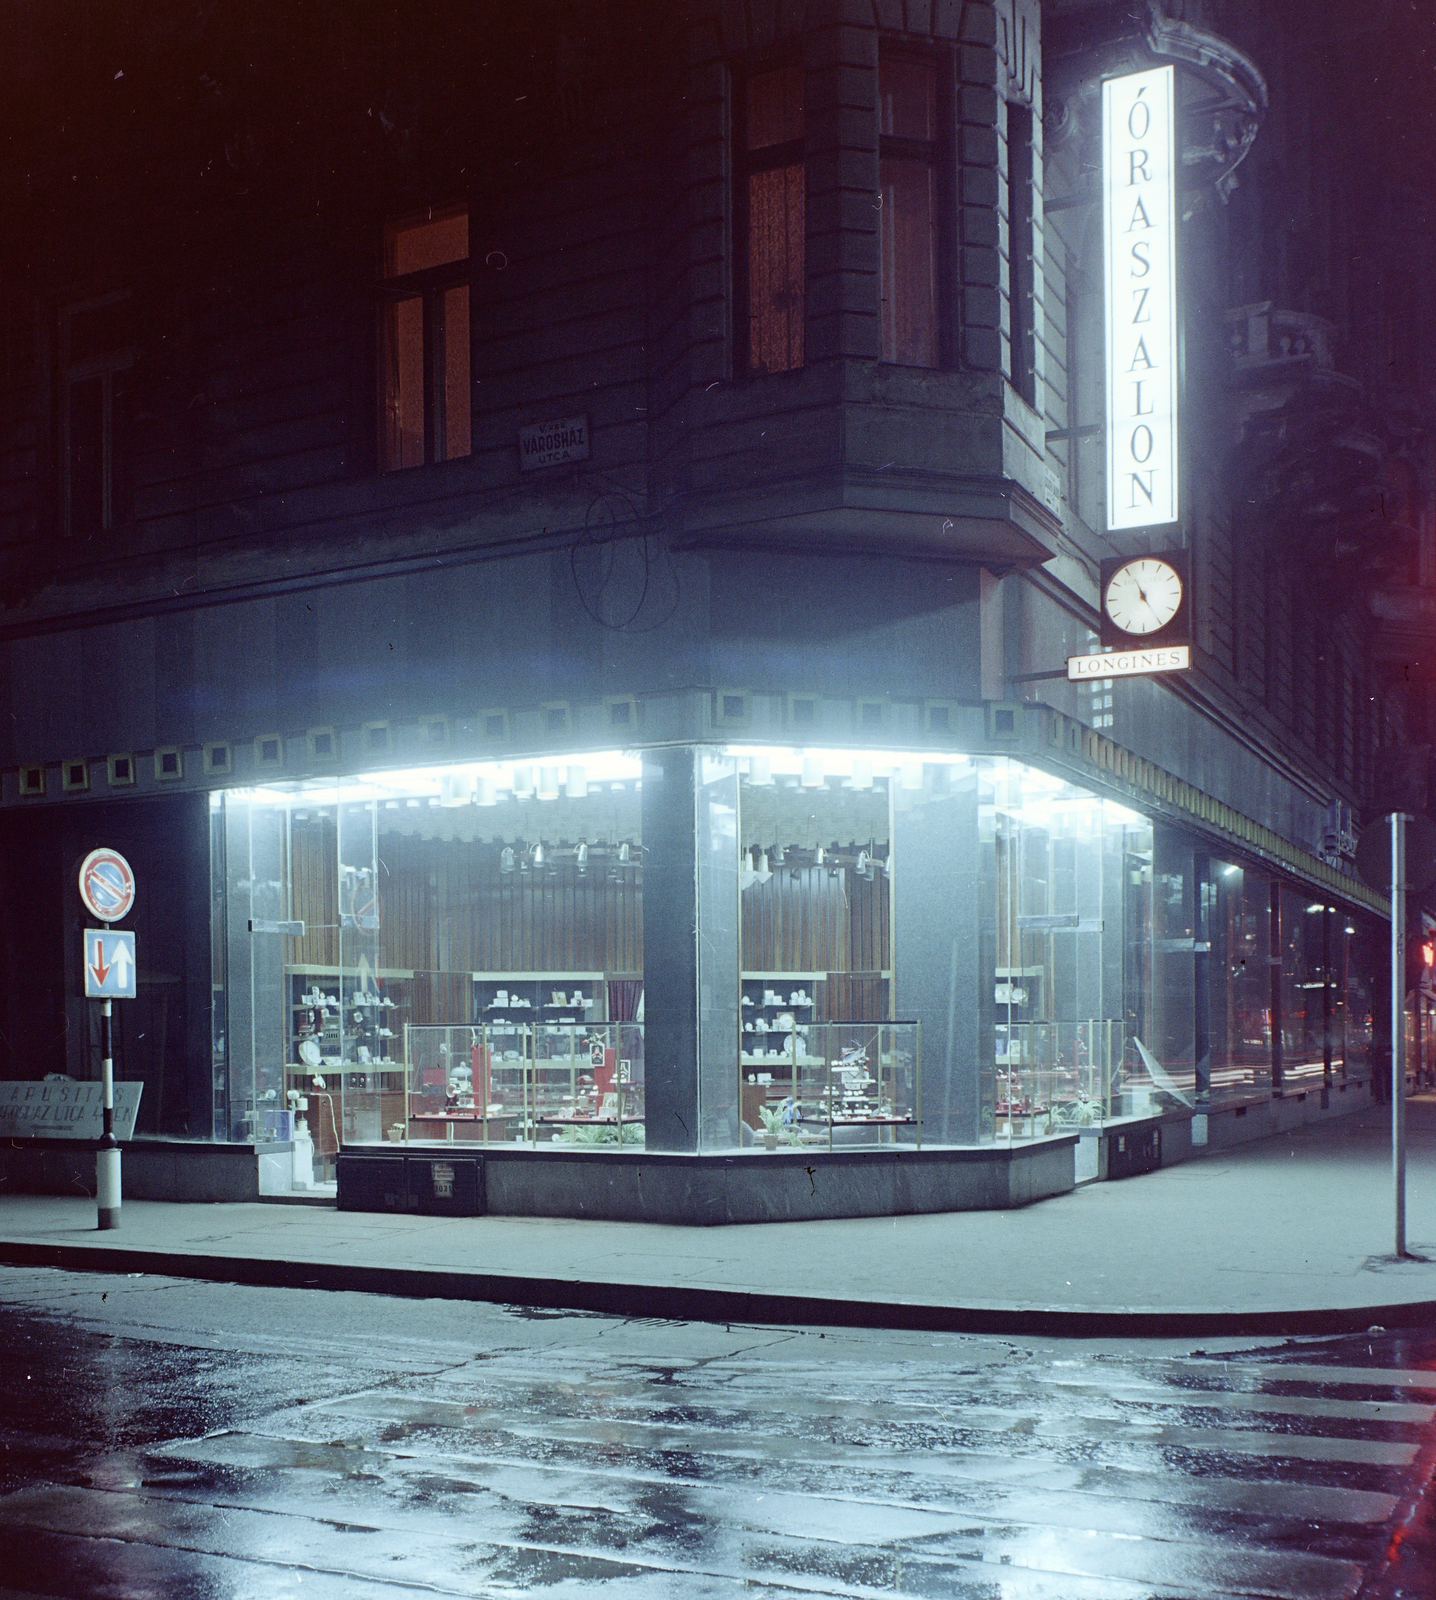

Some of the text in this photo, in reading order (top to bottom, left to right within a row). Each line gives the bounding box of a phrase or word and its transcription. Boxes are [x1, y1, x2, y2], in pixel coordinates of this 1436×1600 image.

[1124, 86, 1159, 509] ÓRASZALON
[538, 450, 571, 464] UTCA
[1076, 651, 1181, 674] LONGINES
[54, 1105, 86, 1122] UTCA
